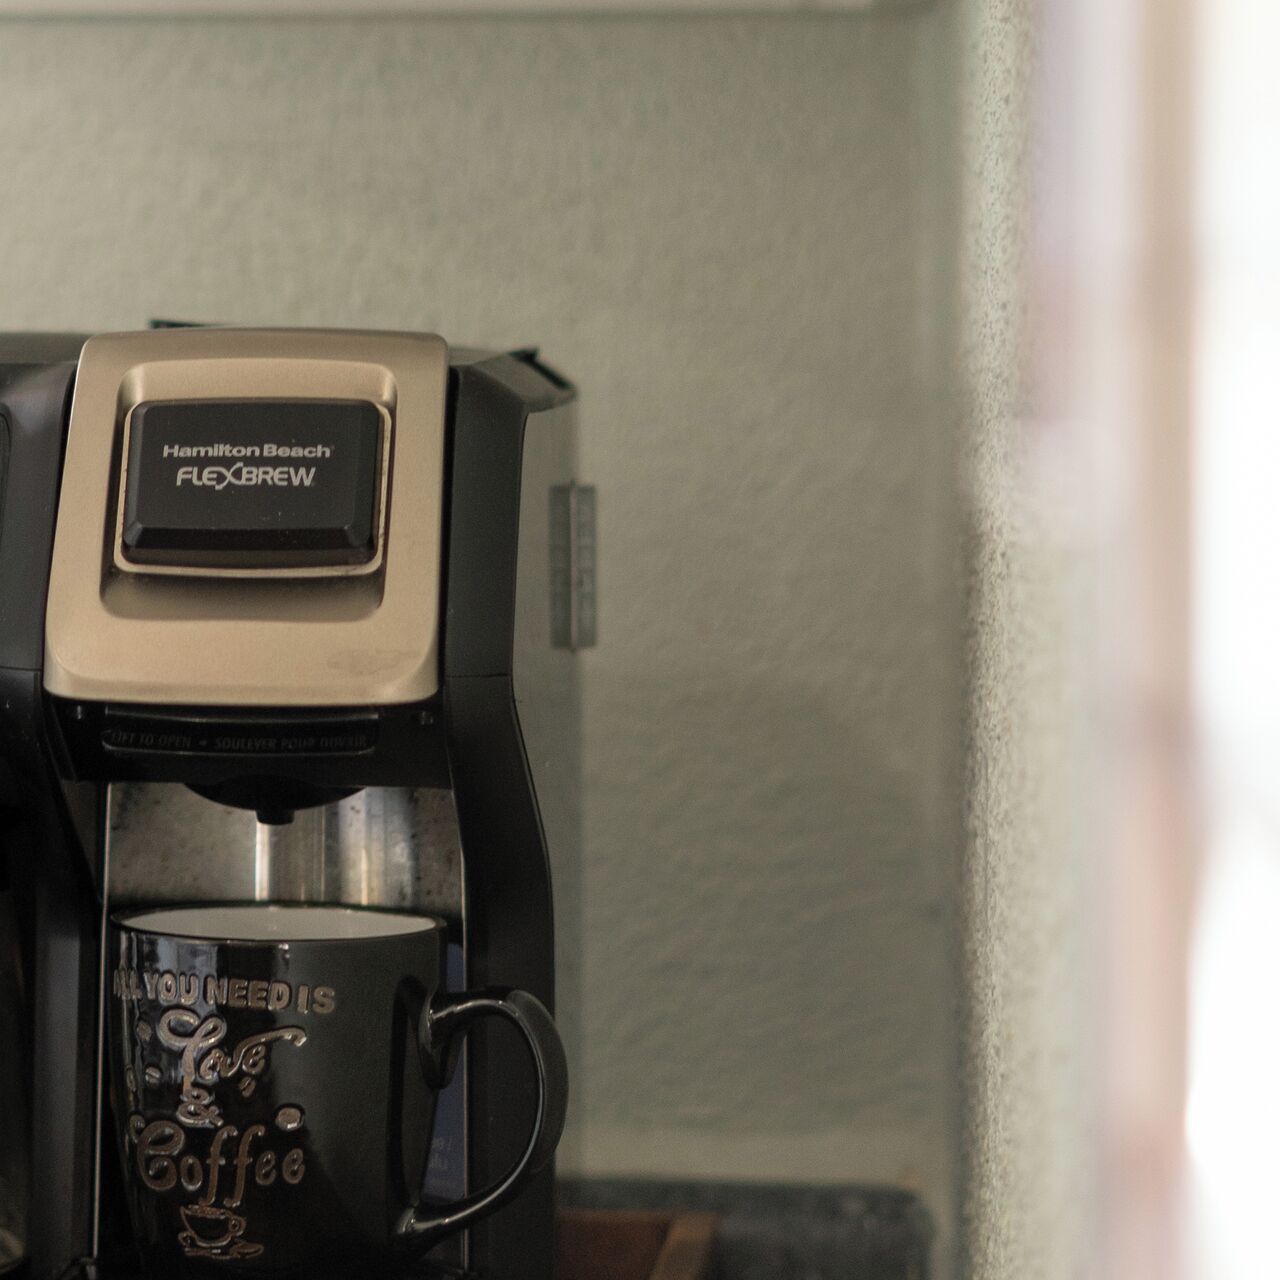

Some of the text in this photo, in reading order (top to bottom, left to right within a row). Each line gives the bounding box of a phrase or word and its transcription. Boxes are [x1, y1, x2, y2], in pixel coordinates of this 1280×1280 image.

[163, 443, 331, 458] Hamilton Beach
[176, 462, 317, 490] FLEXBREW
[159, 734, 192, 748] OPEN
[144, 971, 198, 1005] YOU
[206, 976, 292, 1011] NEED
[297, 984, 336, 1014] IS
[156, 1008, 307, 1093] Love
[137, 1120, 305, 1208] Coffee
